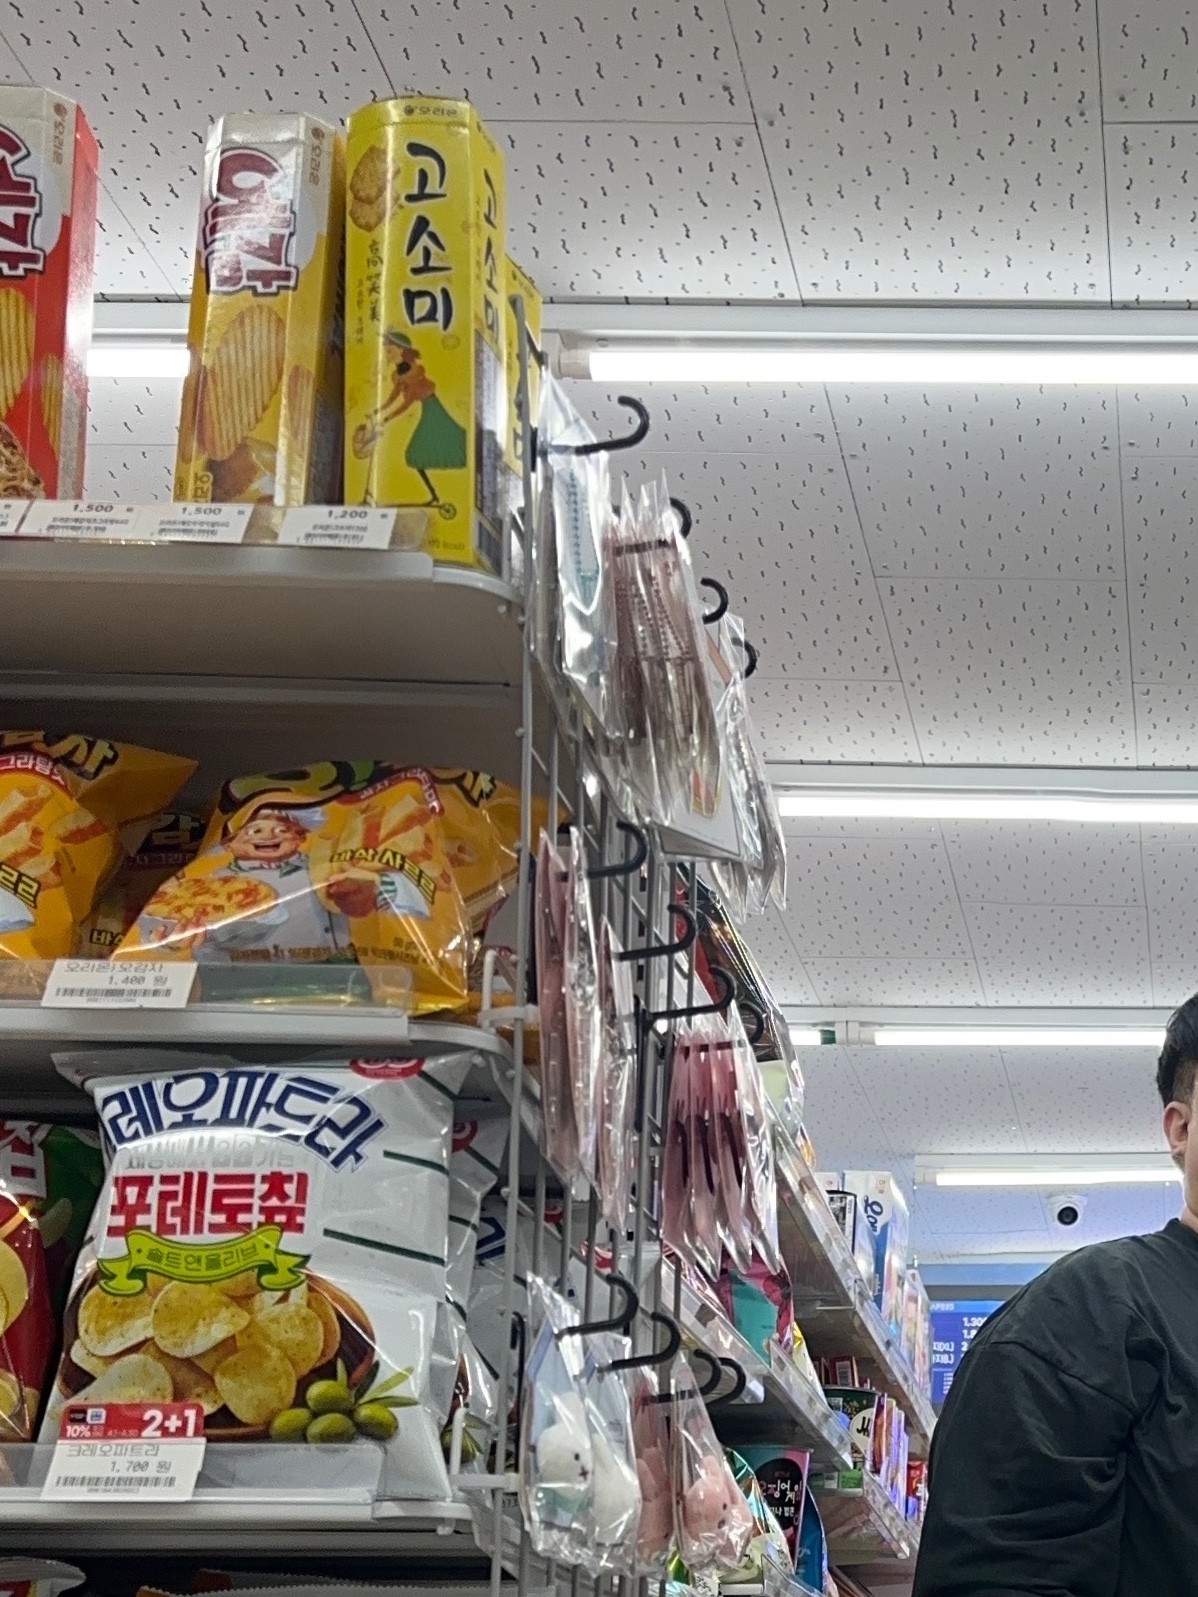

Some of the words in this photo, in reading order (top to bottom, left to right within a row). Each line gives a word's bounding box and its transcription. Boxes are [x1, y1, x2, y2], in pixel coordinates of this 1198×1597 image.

[403, 142, 453, 331] 고소미
[106, 1170, 310, 1238] 포테토칩
[140, 1408, 197, 1438] 2+1
